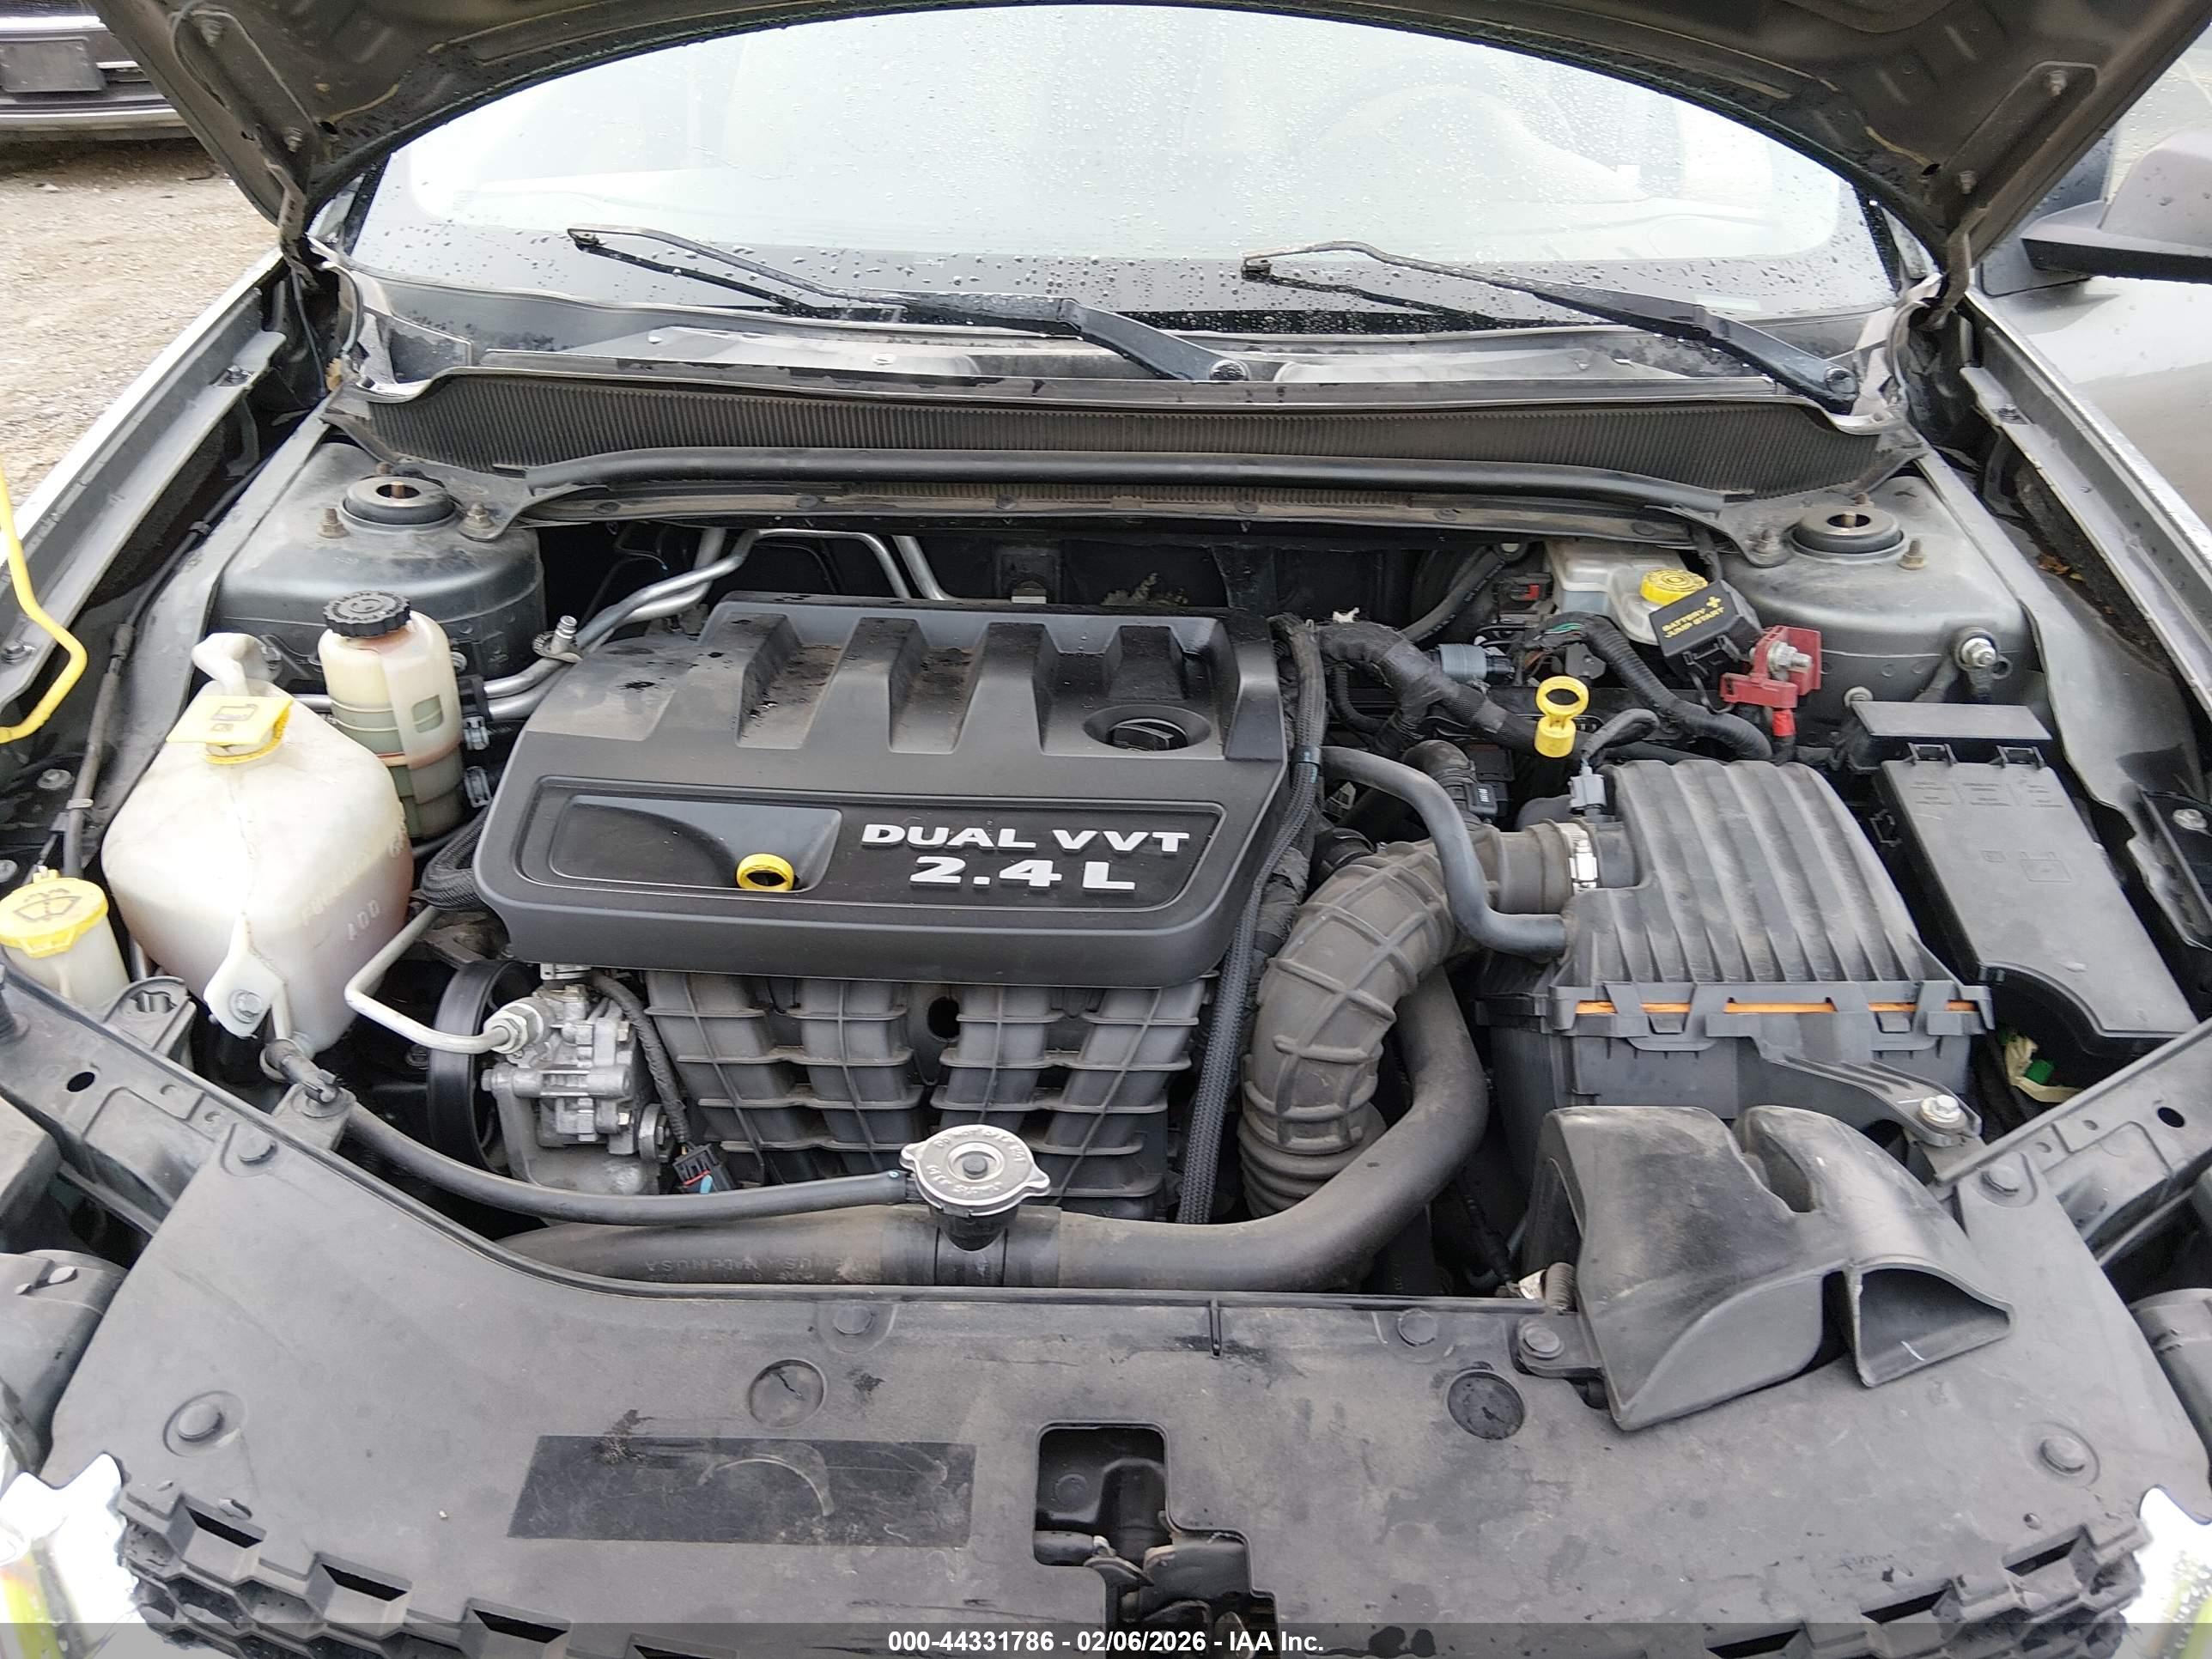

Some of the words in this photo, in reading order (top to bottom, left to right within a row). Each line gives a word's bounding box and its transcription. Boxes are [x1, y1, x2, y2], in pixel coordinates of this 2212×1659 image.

[860, 823, 1037, 850] DUAL
[1052, 830, 1190, 853] VVT
[909, 855, 1063, 888] 2.4
[1082, 860, 1136, 890] L
